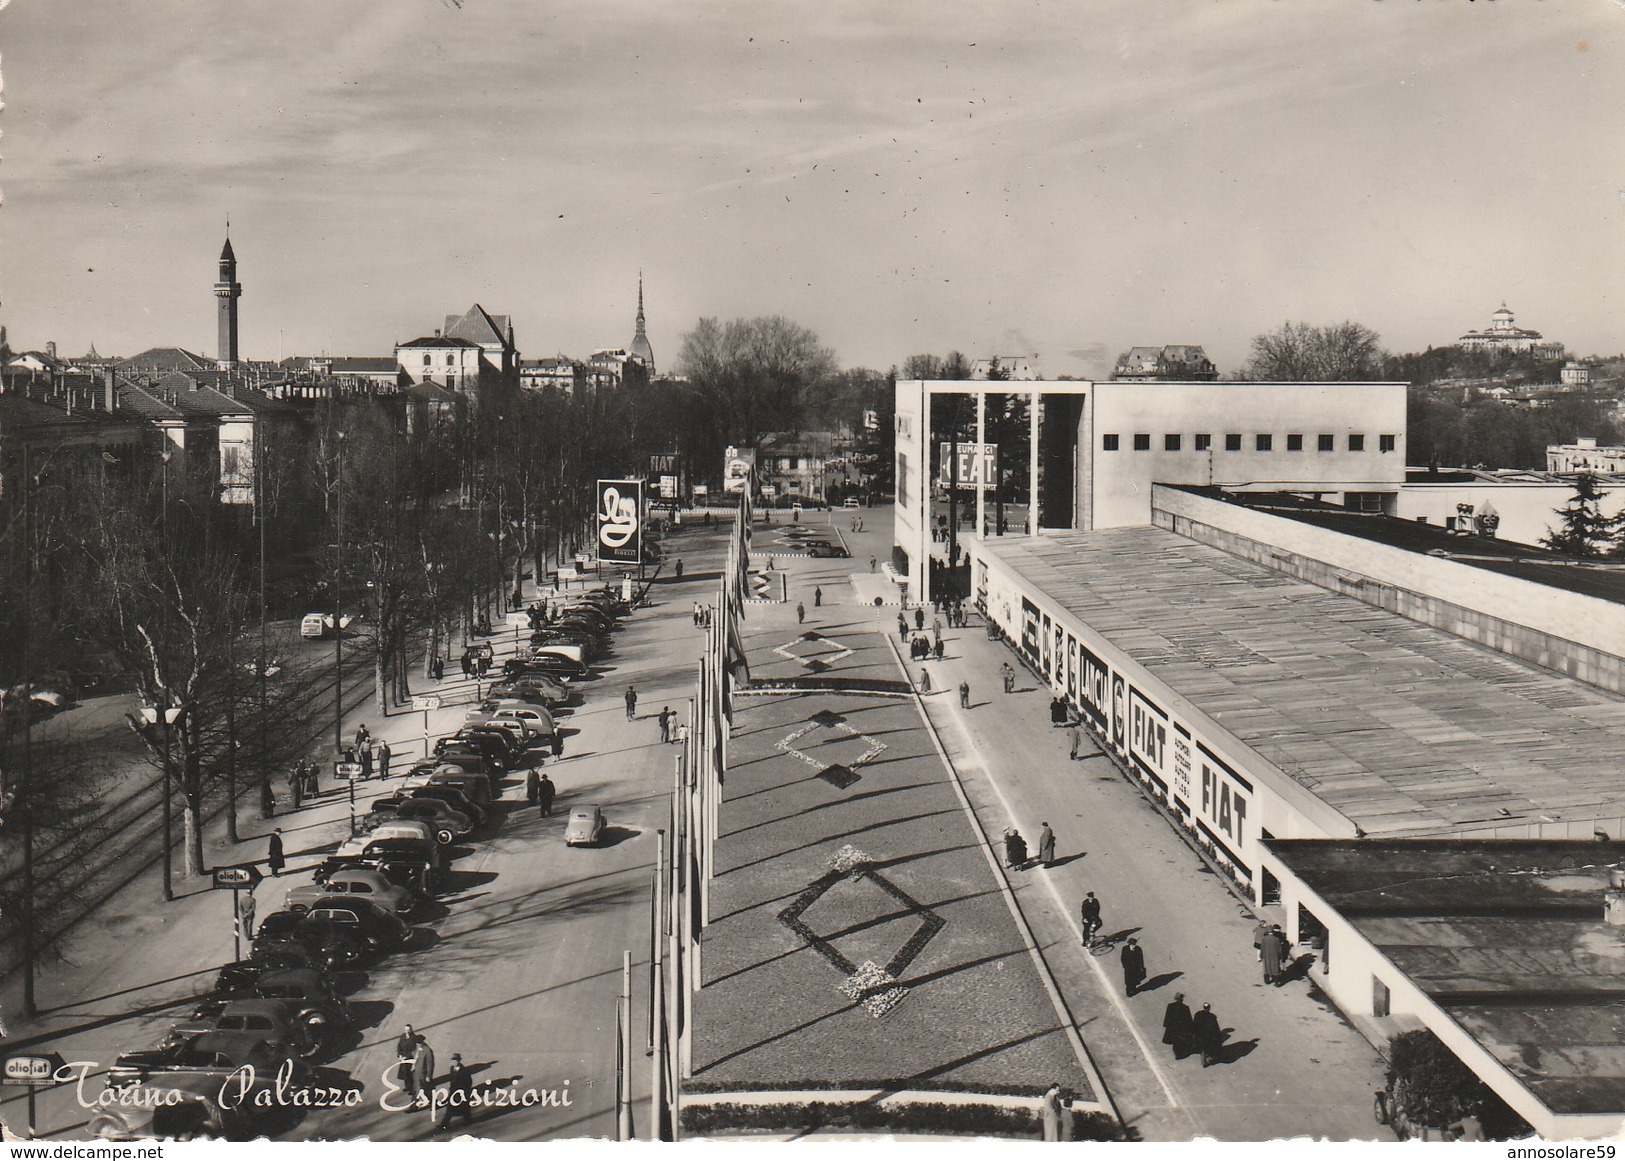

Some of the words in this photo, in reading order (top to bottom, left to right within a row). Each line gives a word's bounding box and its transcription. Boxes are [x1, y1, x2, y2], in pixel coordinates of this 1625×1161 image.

[650, 455, 675, 471] FIAT
[1081, 655, 1109, 718] LANCIA
[1135, 703, 1166, 770] FIAT
[340, 763, 361, 773] oliofat
[1202, 763, 1247, 849] FIAT
[9, 1060, 47, 1075] oliofiat
